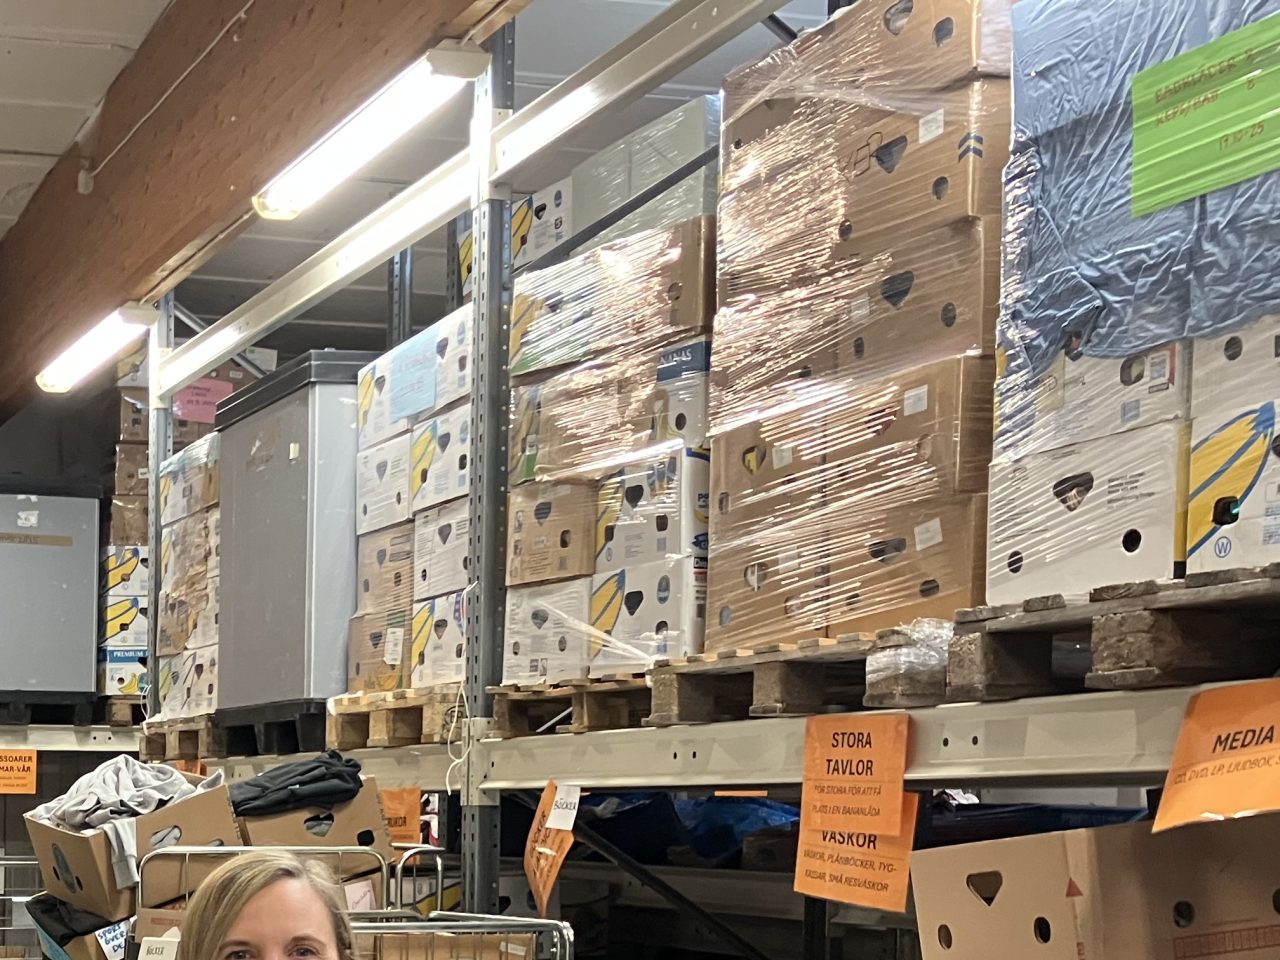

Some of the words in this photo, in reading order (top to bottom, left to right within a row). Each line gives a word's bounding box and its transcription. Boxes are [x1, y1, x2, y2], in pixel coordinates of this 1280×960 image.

[113, 651, 144, 659] PREMIUM
[831, 731, 873, 749] STORA
[1212, 724, 1276, 754] MEDIA
[826, 758, 874, 777] TAVLOR
